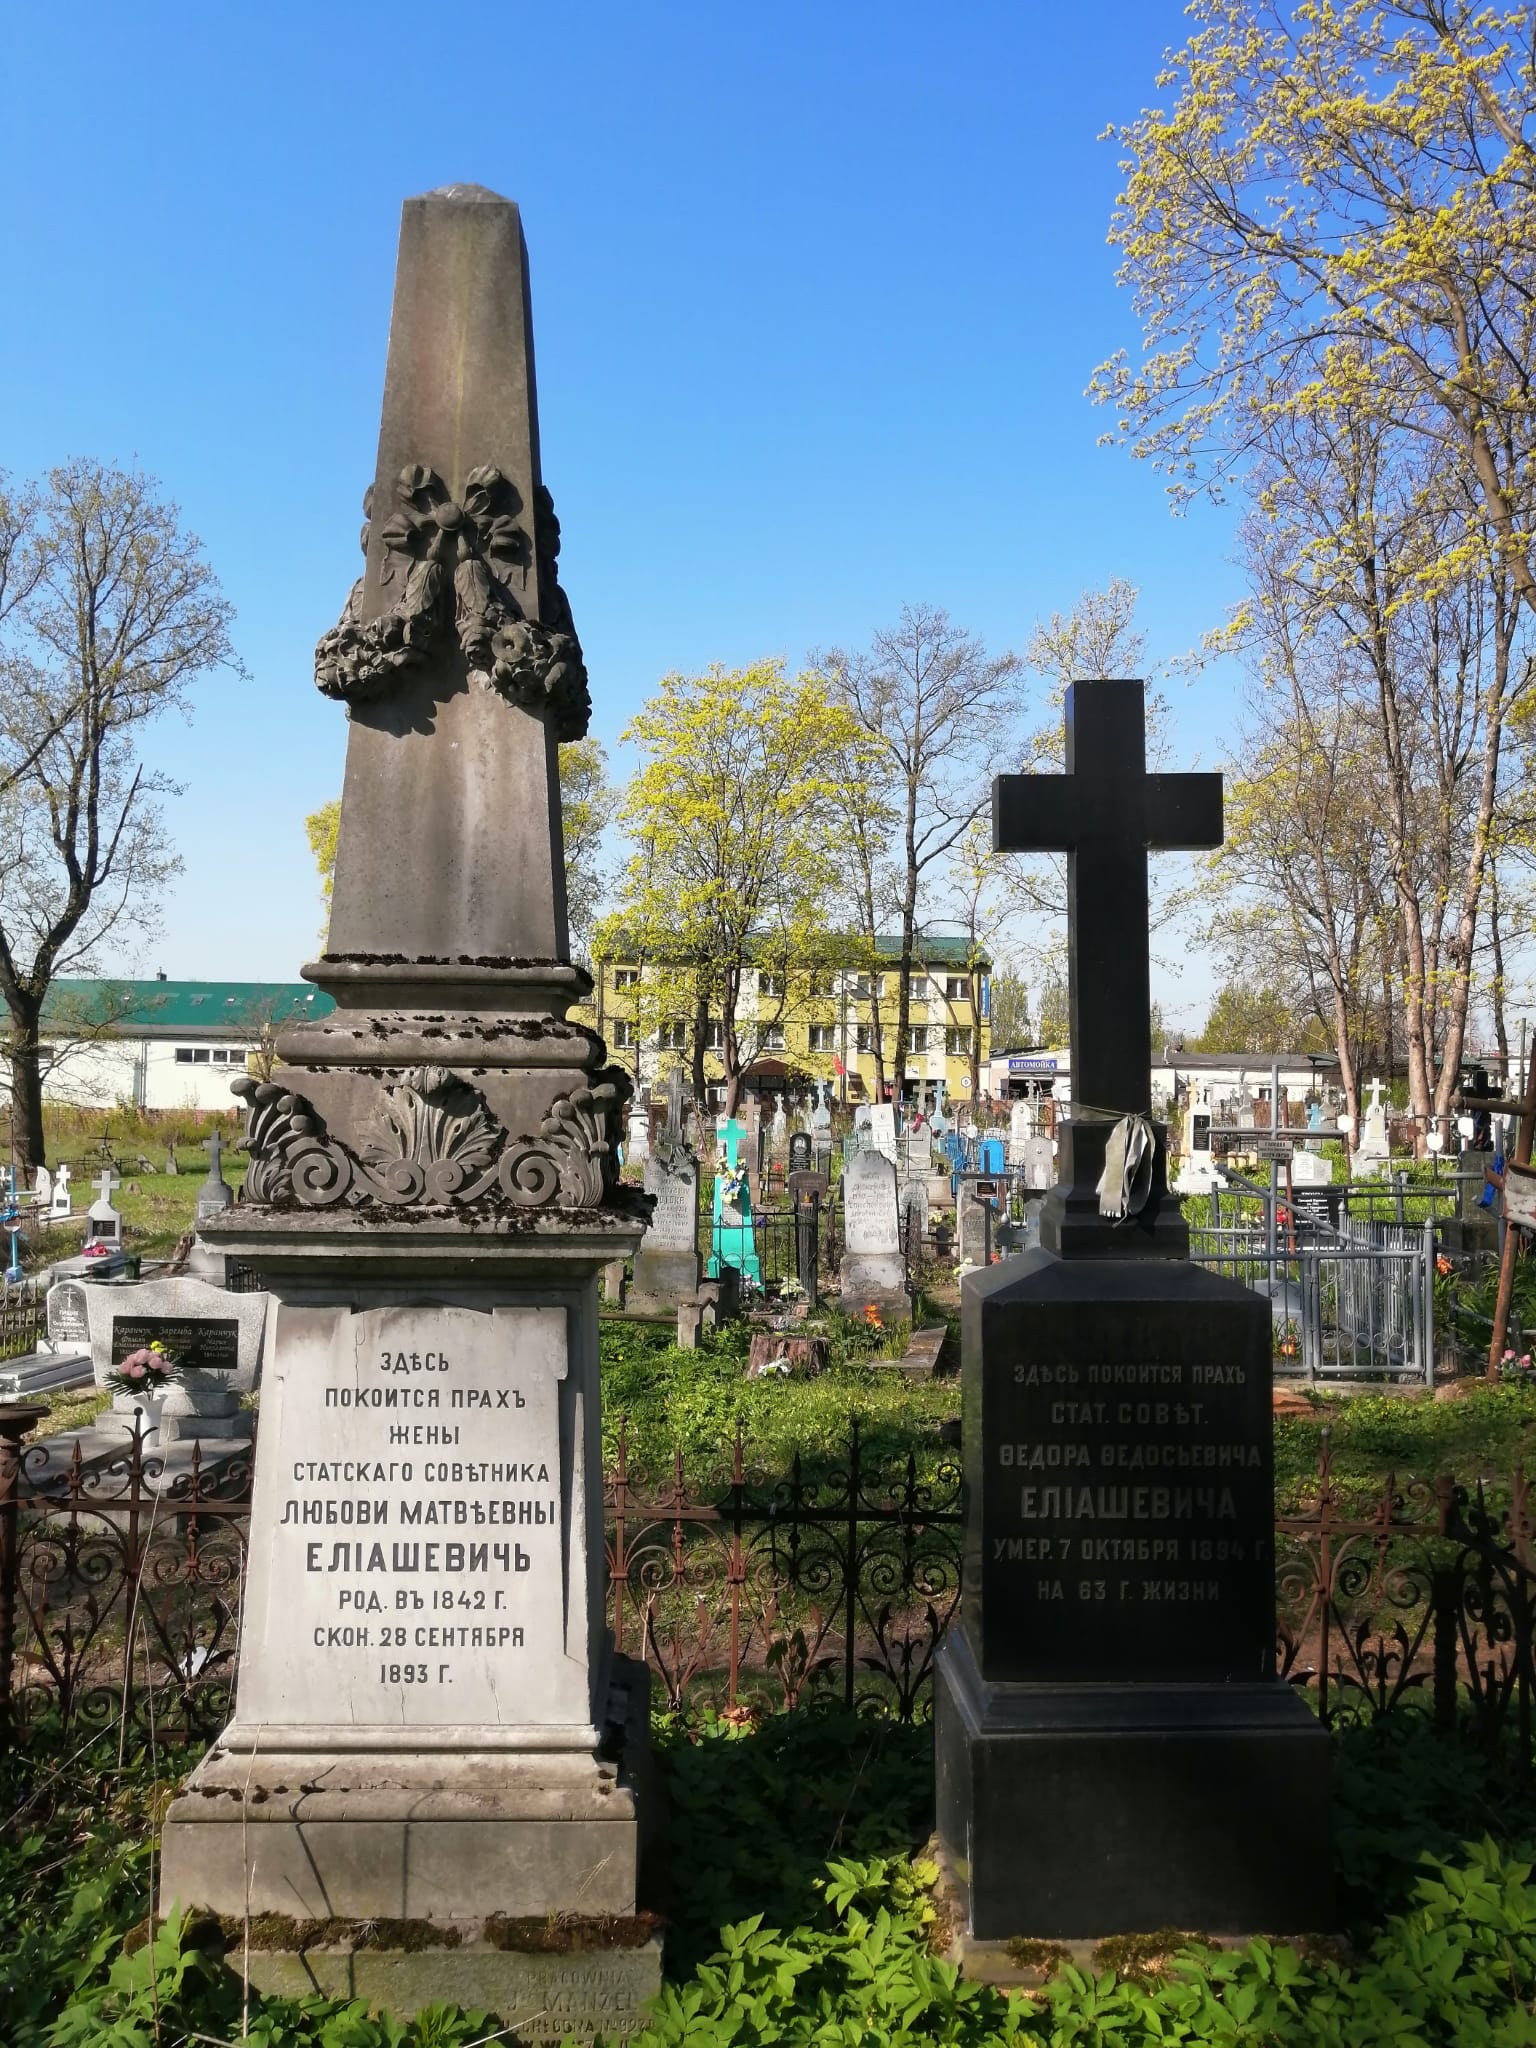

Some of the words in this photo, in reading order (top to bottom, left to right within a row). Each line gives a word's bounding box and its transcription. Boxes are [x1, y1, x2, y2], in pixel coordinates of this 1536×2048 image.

[1011, 1060, 1055, 1069] АВТОМОЙКА
[381, 1353, 448, 1374] ЗДѢСЬ
[1014, 1364, 1079, 1386] ЗДѢСЬ
[1088, 1364, 1182, 1384] ПОКОИТСЯ
[1192, 1365, 1246, 1384] ПРАХЪ
[326, 1388, 439, 1407] ПОКОИТСЯ
[452, 1390, 525, 1408] ПРАХЪ
[1052, 1402, 1109, 1424] СТАТ.
[1118, 1402, 1208, 1424] СОВѢТ.
[390, 1426, 458, 1444] ЖЕНЫ
[295, 1463, 412, 1481] СТАТСКАГО
[425, 1463, 548, 1482] СОВѢТНИКА
[281, 1501, 387, 1524] ЛЮБОВИ
[401, 1501, 554, 1524] МАТВѢЕВНЫ
[1021, 1486, 1237, 1519] ЕЛІАШЕВИЧА
[307, 1543, 530, 1571] ЕЛІАШЕВИЧЬ
[993, 1538, 1053, 1561] УМЕР.
[1060, 1539, 1070, 1560] 7
[1082, 1539, 1178, 1560] ОКТЯБРЯ
[1192, 1540, 1246, 1560] 1894
[1256, 1540, 1270, 1560] Г.
[1038, 1580, 1064, 1600] НА
[1079, 1580, 1106, 1600] 63
[1120, 1580, 1132, 1600] Г.
[1142, 1580, 1220, 1600] ЖИЗНИ
[340, 1591, 387, 1613] РОД.
[396, 1591, 423, 1609] ВЪ
[434, 1591, 485, 1609] 1842
[495, 1591, 506, 1609] Г.
[315, 1628, 373, 1646] СКОН.
[380, 1628, 406, 1646] 28
[416, 1628, 523, 1646] СЕНТЯБРЯ
[381, 1664, 427, 1683] 1893
[440, 1665, 452, 1683] Г.
